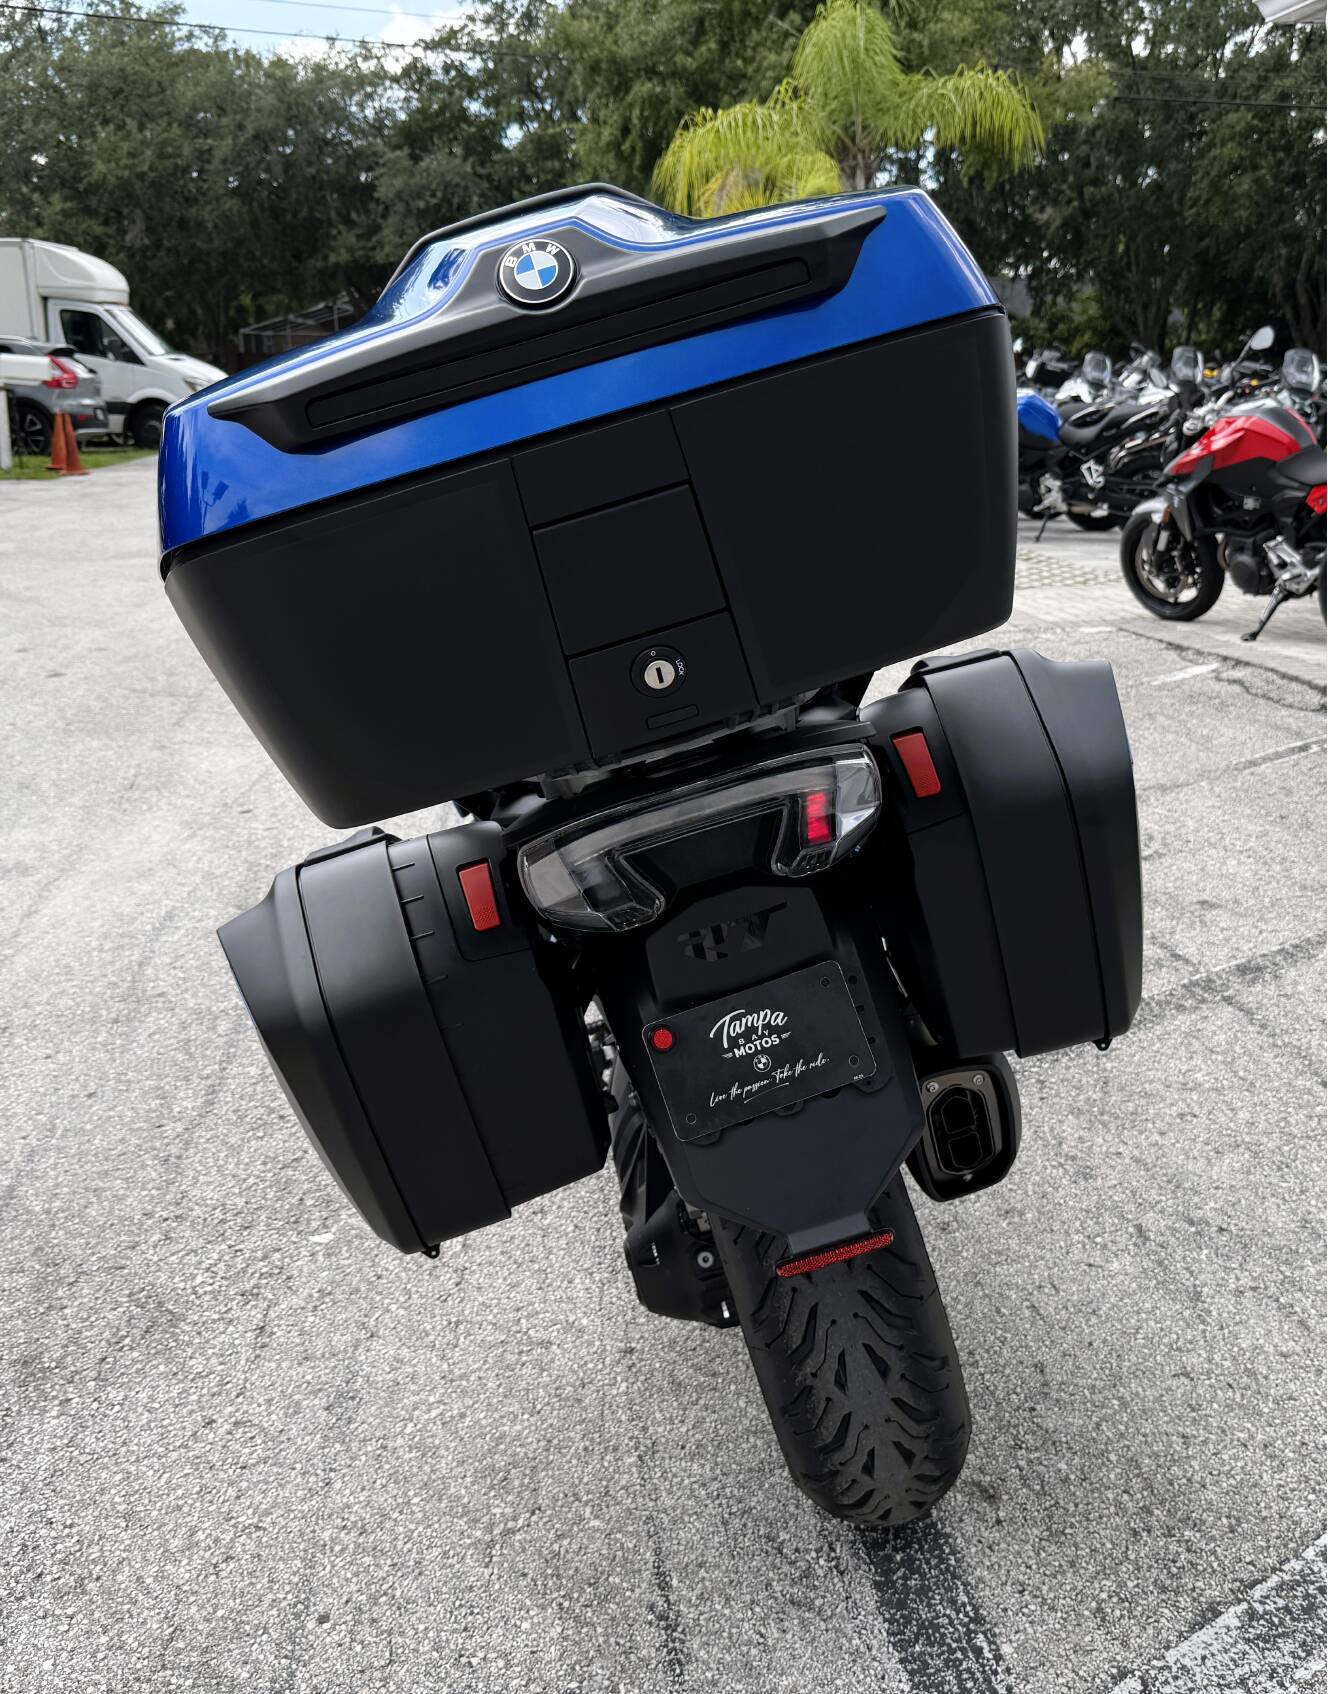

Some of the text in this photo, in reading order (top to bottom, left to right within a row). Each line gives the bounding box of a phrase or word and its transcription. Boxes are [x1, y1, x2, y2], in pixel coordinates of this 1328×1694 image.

[505, 242, 560, 268] BMW
[676, 658, 685, 676] LOCK
[709, 1008, 788, 1049] Tampa
[738, 1029, 769, 1045] BAY
[733, 1034, 780, 1058] MOTOS
[709, 1092, 728, 1107] Live
[728, 1082, 743, 1101] the
[771, 1063, 794, 1083] Take
[792, 1059, 808, 1077] the
